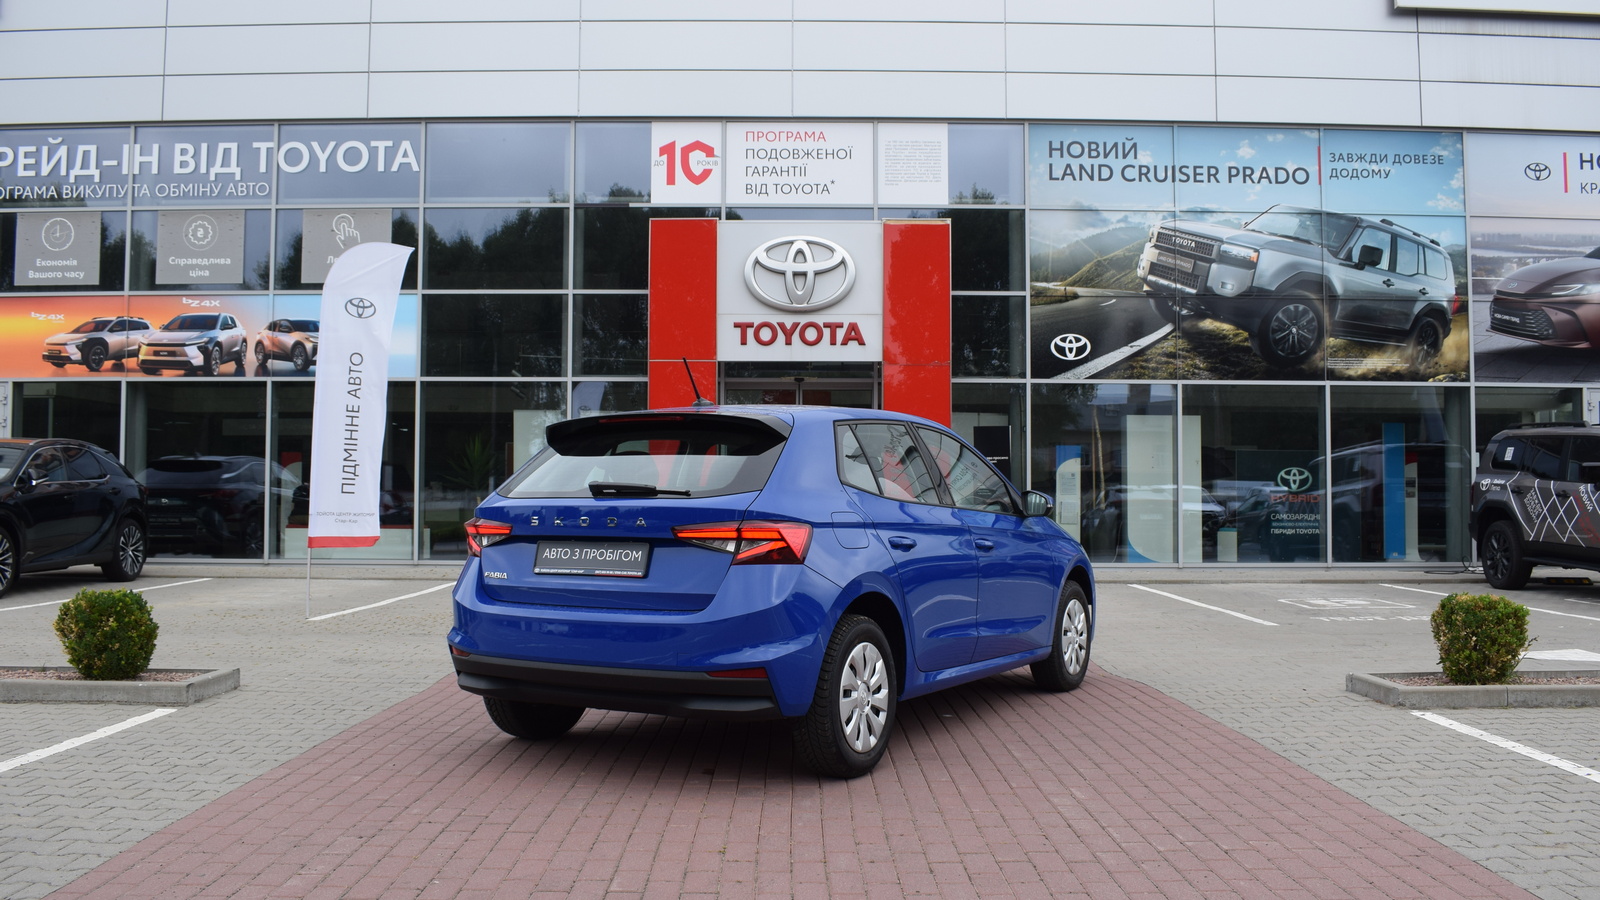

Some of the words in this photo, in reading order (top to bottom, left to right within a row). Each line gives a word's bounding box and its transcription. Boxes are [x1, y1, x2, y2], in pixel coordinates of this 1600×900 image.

[745, 131, 827, 142] ПРОГРАМА
[745, 145, 854, 162] ПОДОВЖЕНОЇ
[1048, 137, 1138, 160] НОВИЙ
[173, 143, 242, 181] ВІД
[252, 140, 420, 173] TOYOTA
[1329, 152, 1388, 165] ЗАВЖДИ
[1392, 154, 1444, 165] ДОВЕЗЕ
[745, 163, 808, 177] ГАРАНТІЇ
[1048, 163, 1114, 182] LAND
[1120, 164, 1221, 184] CRUISER
[1227, 166, 1310, 185] PRADO
[1329, 168, 1391, 180] ДОДОМУ
[62, 184, 128, 198] ВИКУПУ
[133, 184, 150, 197] ТА
[155, 182, 222, 197] ОБМІНУ
[226, 182, 269, 197] АВТО
[745, 183, 769, 197] ВІД
[1580, 182, 1600, 195] КР
[1172, 236, 1196, 248] TOYOTA
[36, 258, 77, 267] Економія
[169, 257, 231, 266] Справедлива
[28, 270, 62, 279] Вашого
[64, 271, 85, 279] часу
[189, 269, 209, 278] ціна
[733, 321, 866, 346] TOYOTA
[347, 352, 364, 399] АВТО
[341, 404, 360, 495] ПІДМІННЕ
[1579, 484, 1594, 512] НОВИЙ
[1271, 513, 1320, 521] САМОЗАРЯДНІ
[542, 548, 570, 560] АВТО
[582, 548, 642, 561] ПРОБІГОМ
